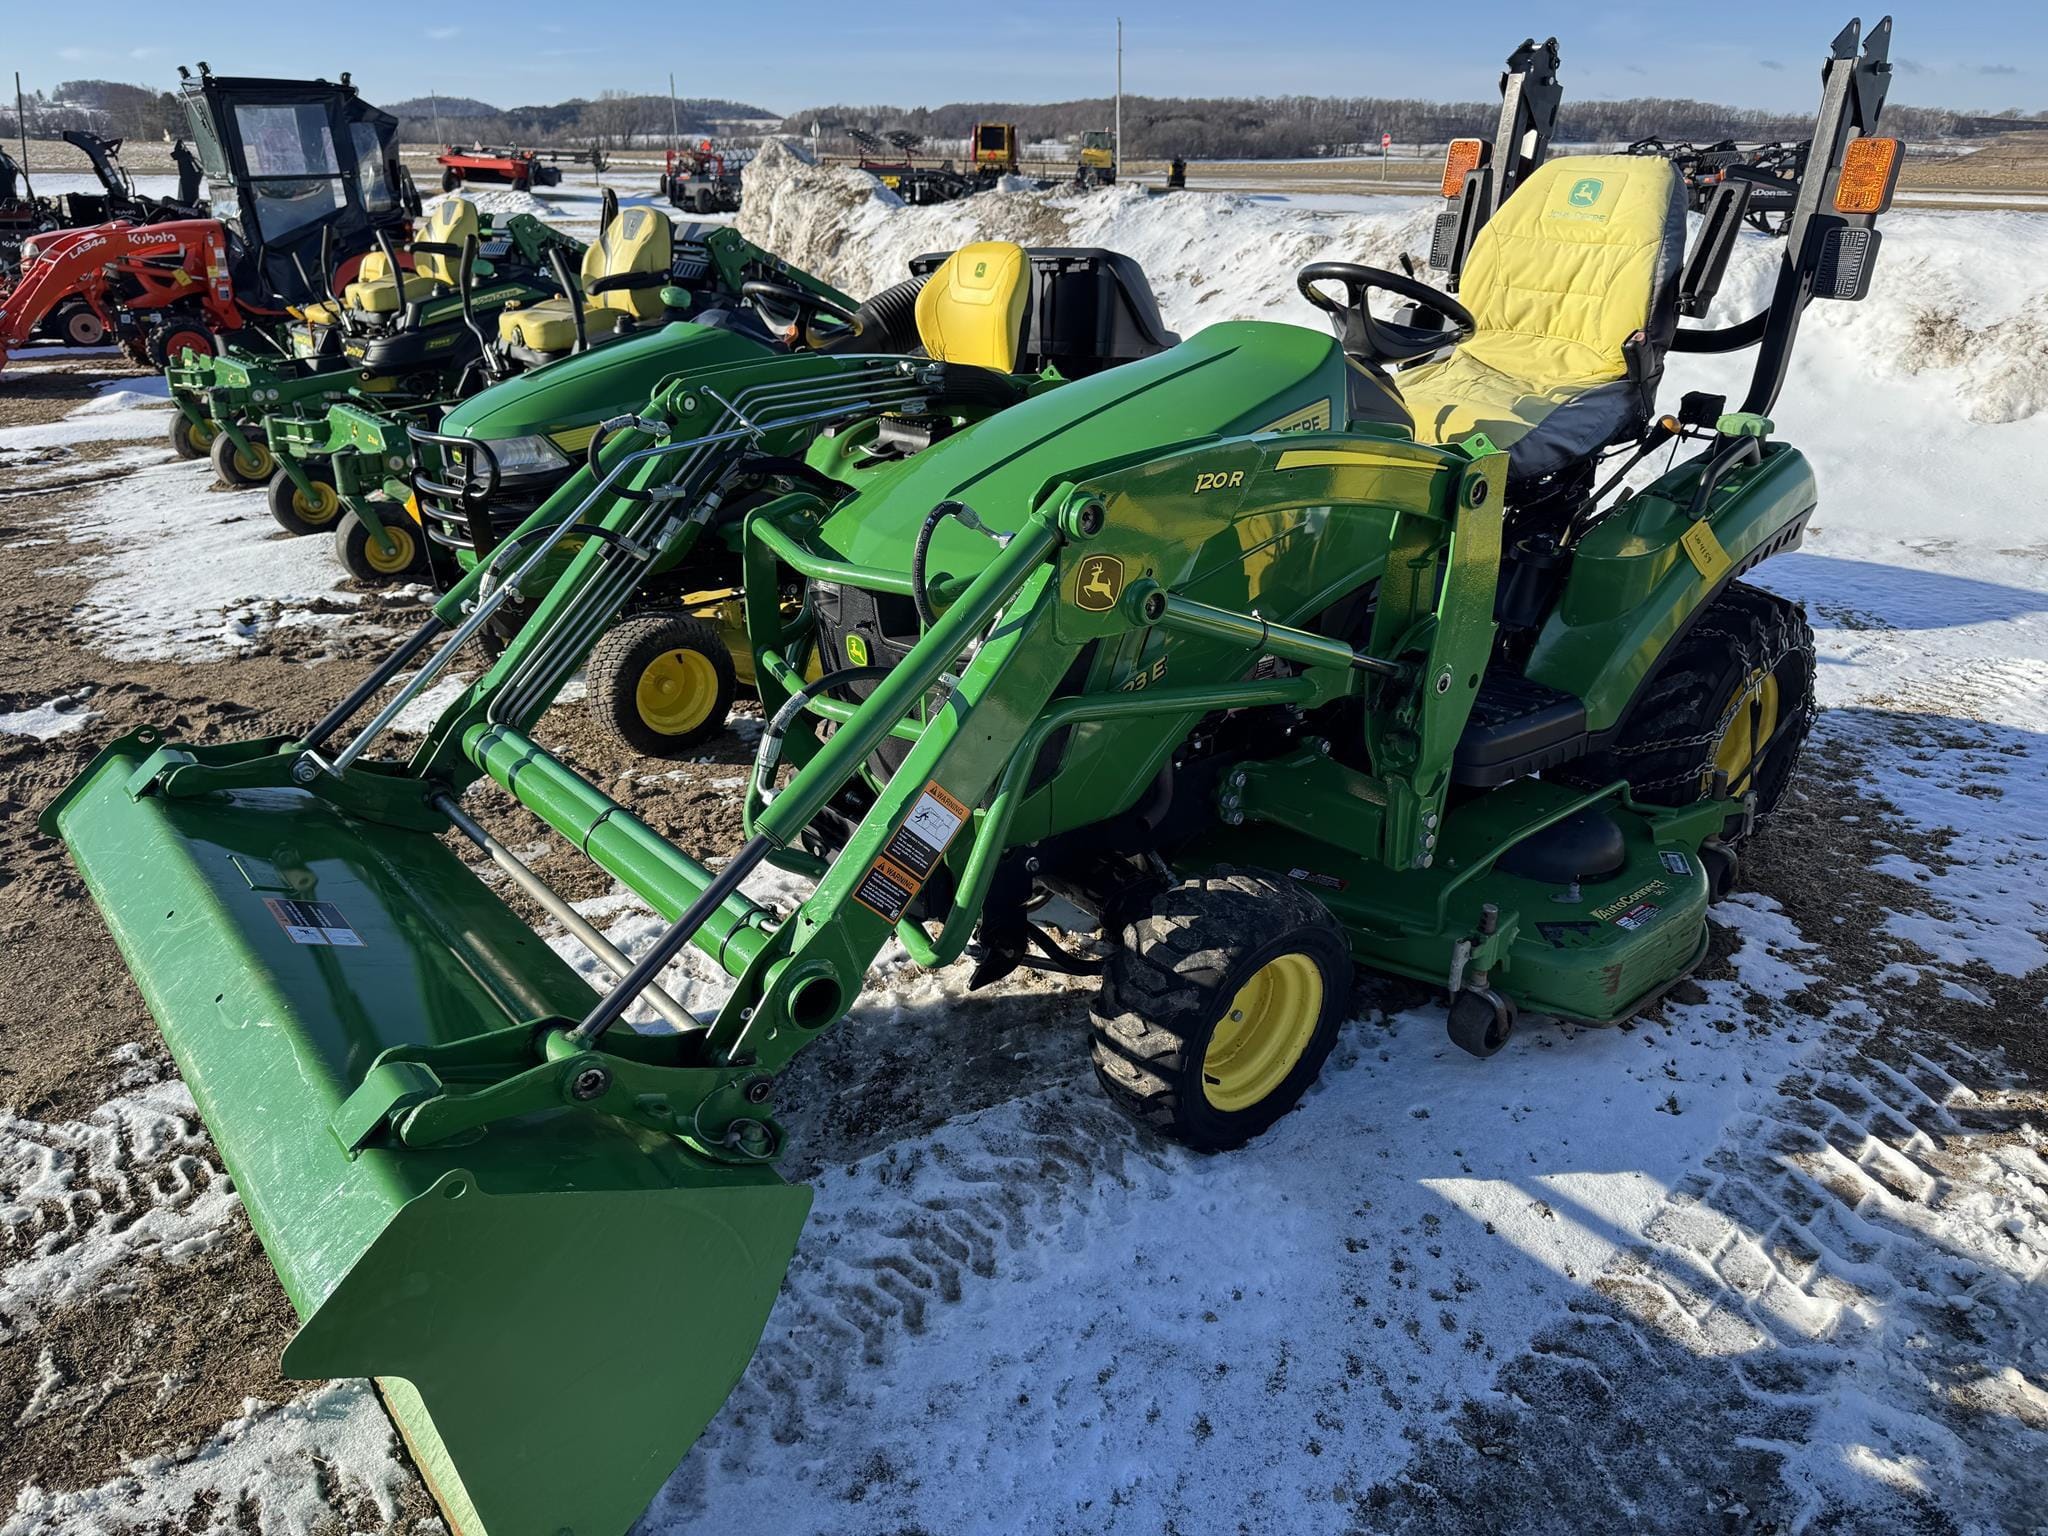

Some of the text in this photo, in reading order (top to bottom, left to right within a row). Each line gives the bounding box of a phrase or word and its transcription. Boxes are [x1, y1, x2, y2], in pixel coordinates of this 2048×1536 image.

[69, 236, 107, 260] LA344
[128, 232, 177, 245] Kubota
[937, 790, 964, 816] WARNING
[886, 866, 915, 890] WARNING
